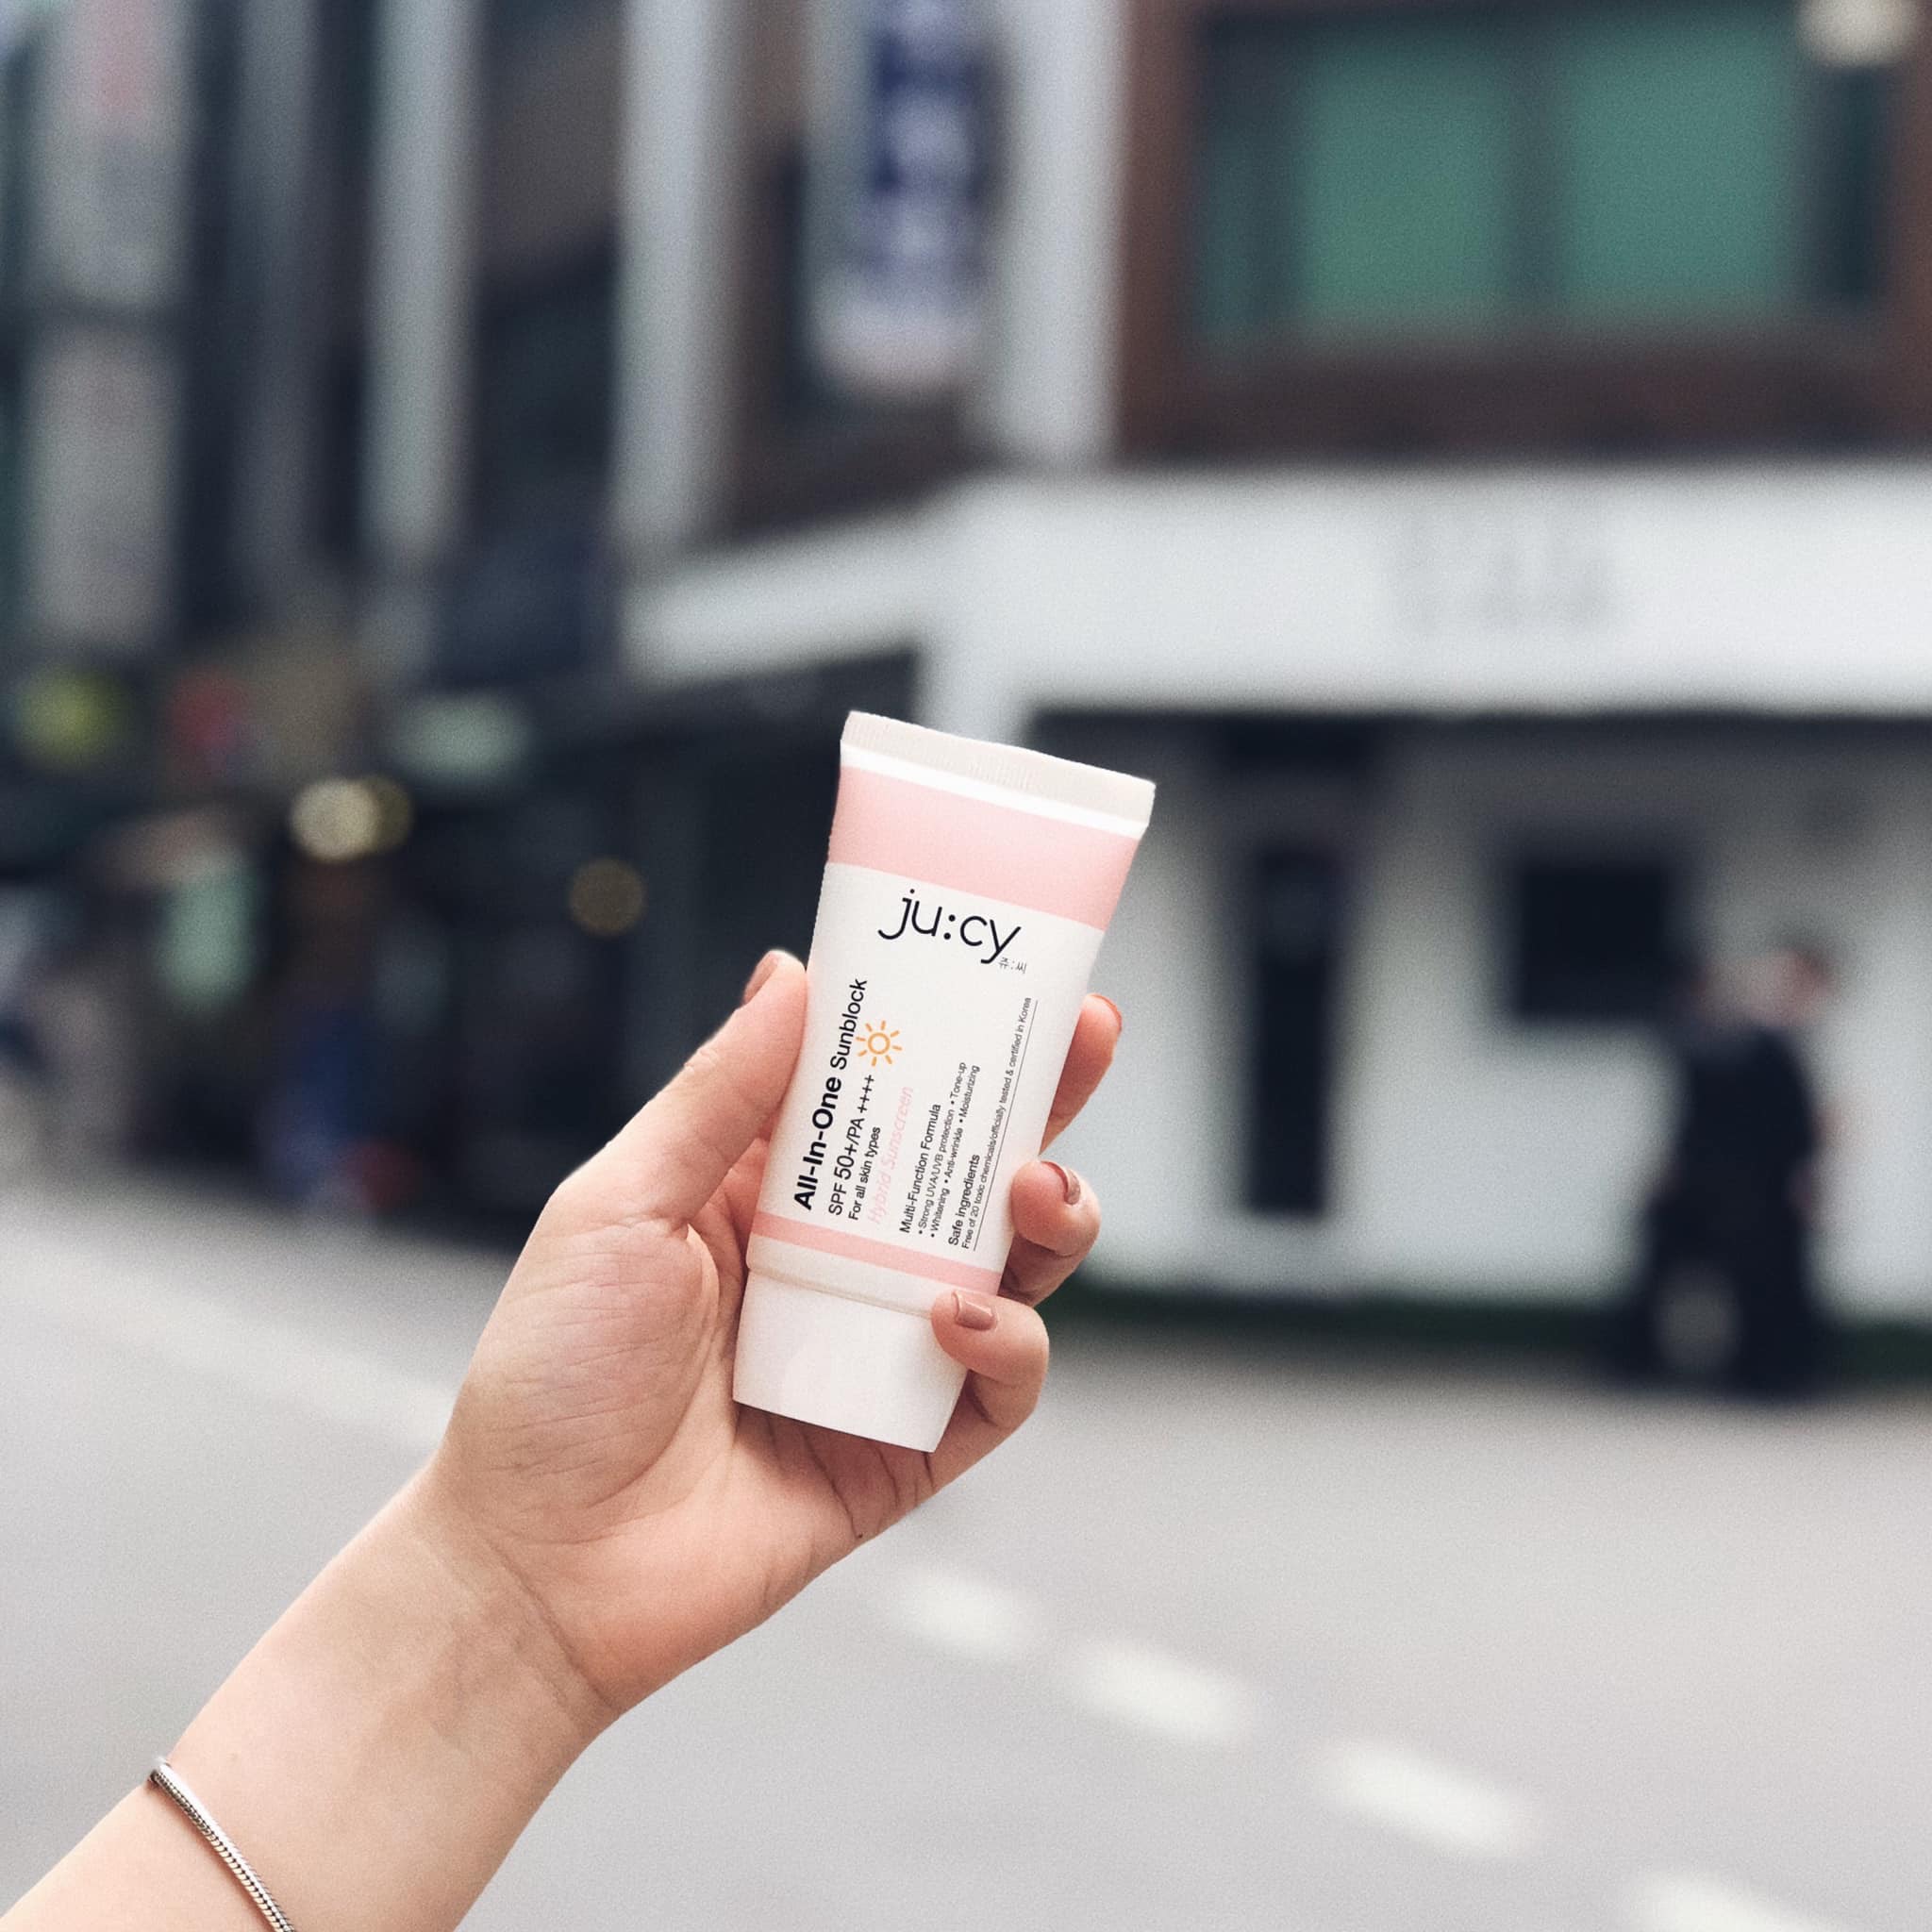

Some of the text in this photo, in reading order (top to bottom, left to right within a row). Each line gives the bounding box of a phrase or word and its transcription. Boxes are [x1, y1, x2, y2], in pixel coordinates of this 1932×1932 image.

[877, 888, 1022, 964] ju:cy
[1018, 998, 1031, 1023] Korea
[1015, 1024, 1025, 1033] in
[1009, 1034, 1022, 1067] certified
[1005, 1069, 1015, 1077] &
[793, 978, 867, 1210] All-In-One Sunblock
[999, 1077, 1011, 1103] tested
[833, 1118, 865, 1180] 50+/PA
[868, 1087, 913, 1224] Hybrid Sunscreen
[918, 1062, 967, 1228] Strong UVA/UVB protection Tone-up
[930, 1065, 980, 1231] Whitening Anti-wrinkle Moisturizing
[848, 1126, 880, 1220] For all skin types
[899, 1105, 941, 1233] Multi-Function Formula
[828, 1182, 847, 1215] SPF
[948, 1155, 980, 1245] Safe ingredients
[974, 1185, 985, 1204] toxic
[969, 1218, 975, 1227] of
[971, 1206, 979, 1217] 20
[961, 1229, 974, 1249] Free
